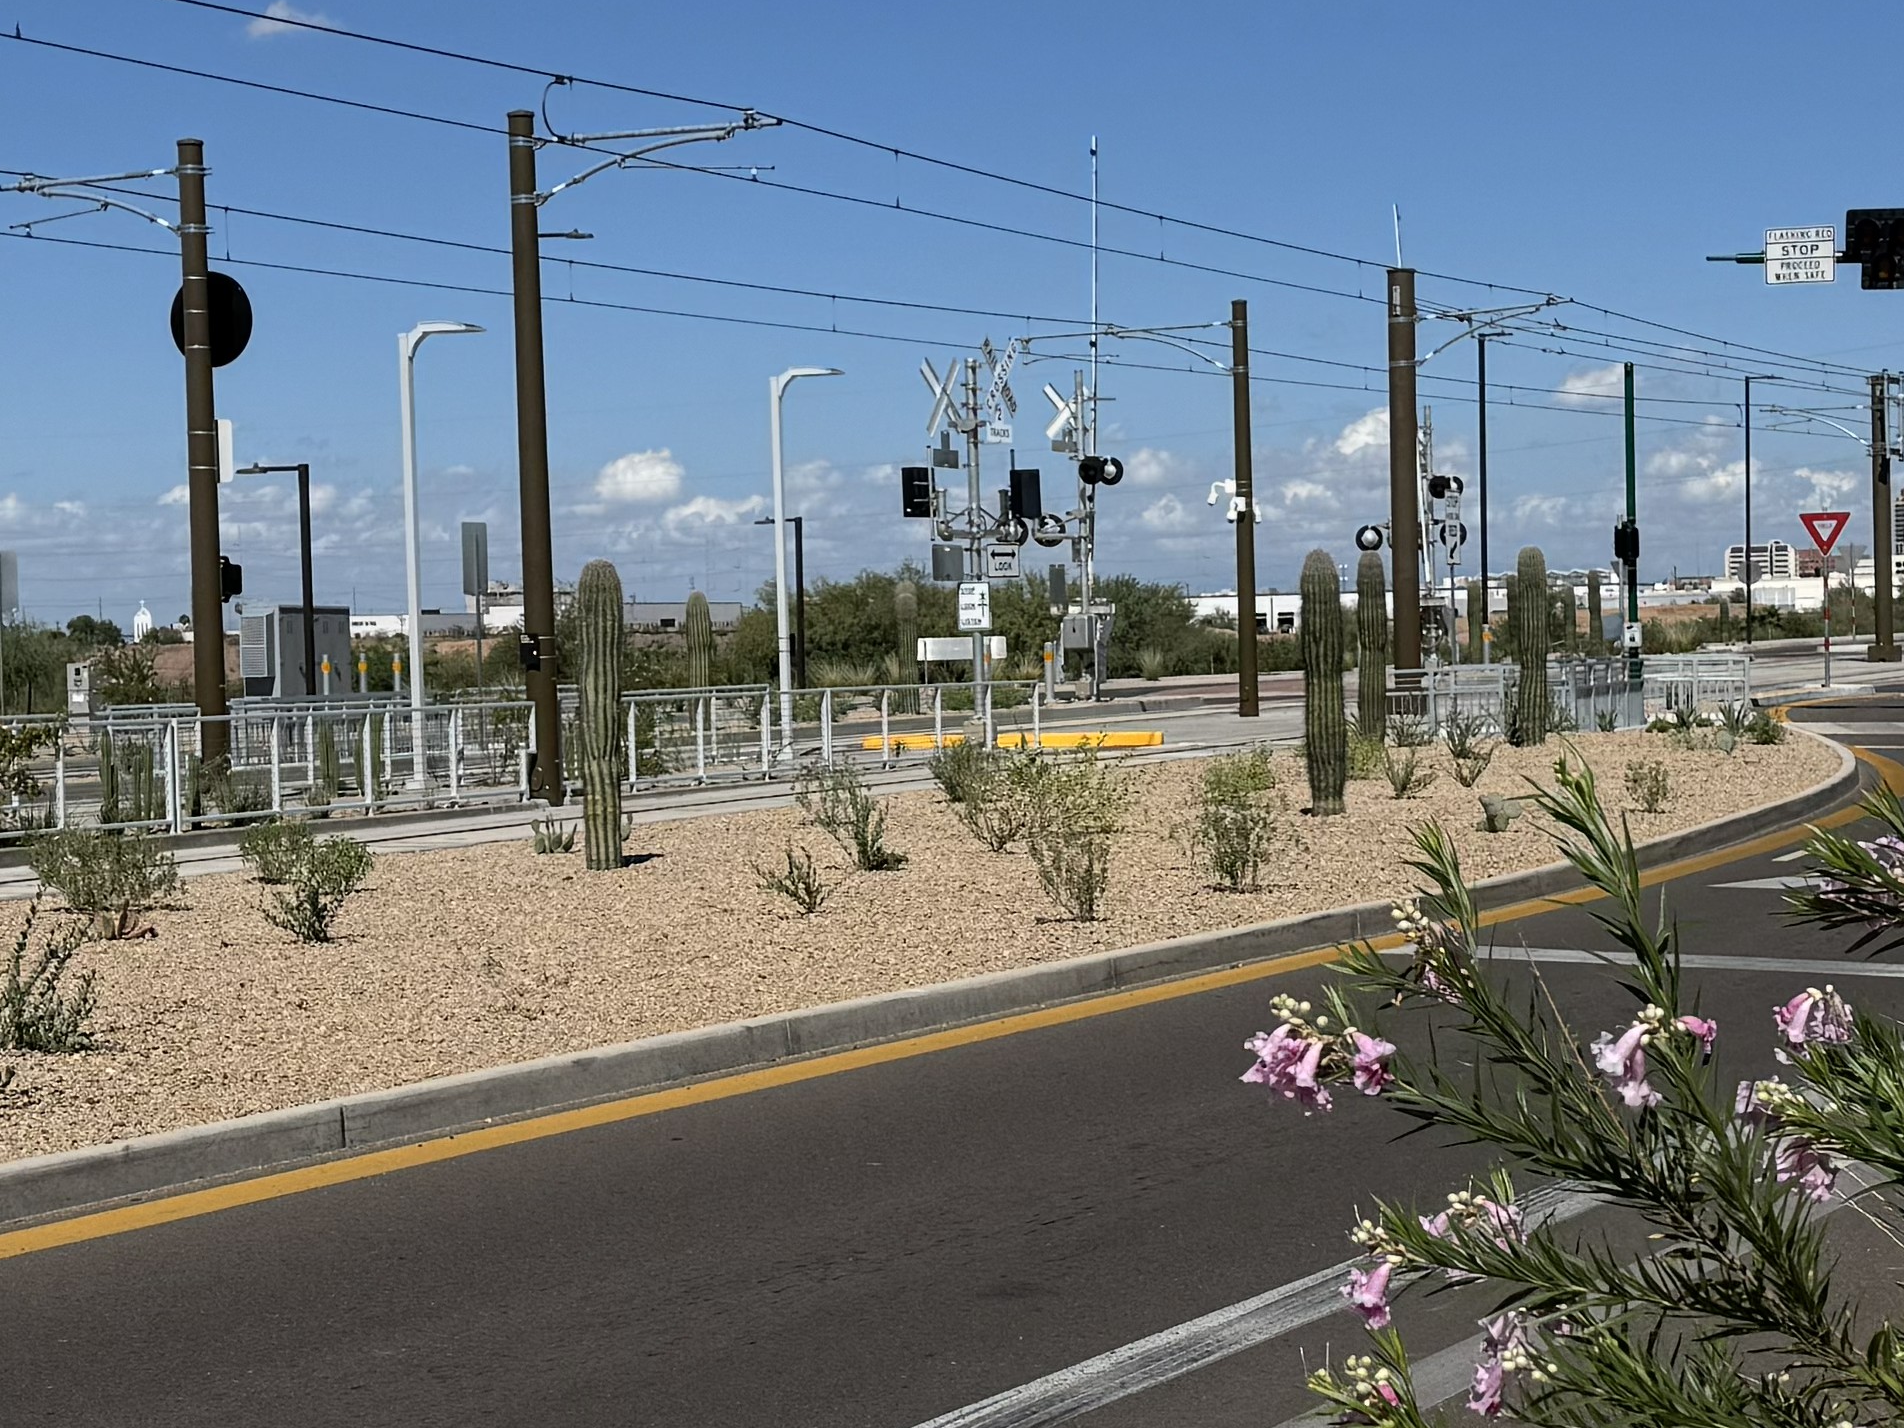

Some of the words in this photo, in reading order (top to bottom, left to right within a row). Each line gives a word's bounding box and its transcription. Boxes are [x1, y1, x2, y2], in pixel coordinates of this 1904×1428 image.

[1768, 230, 1812, 241] FLASHING
[1815, 229, 1832, 239] RED
[1782, 244, 1819, 256] STOP
[1780, 260, 1821, 270] PROCEED
[1775, 272, 1799, 281] WHEN
[1805, 270, 1825, 279] SAFE
[986, 341, 1017, 410] CROSSING
[994, 561, 1012, 571] LOOK
